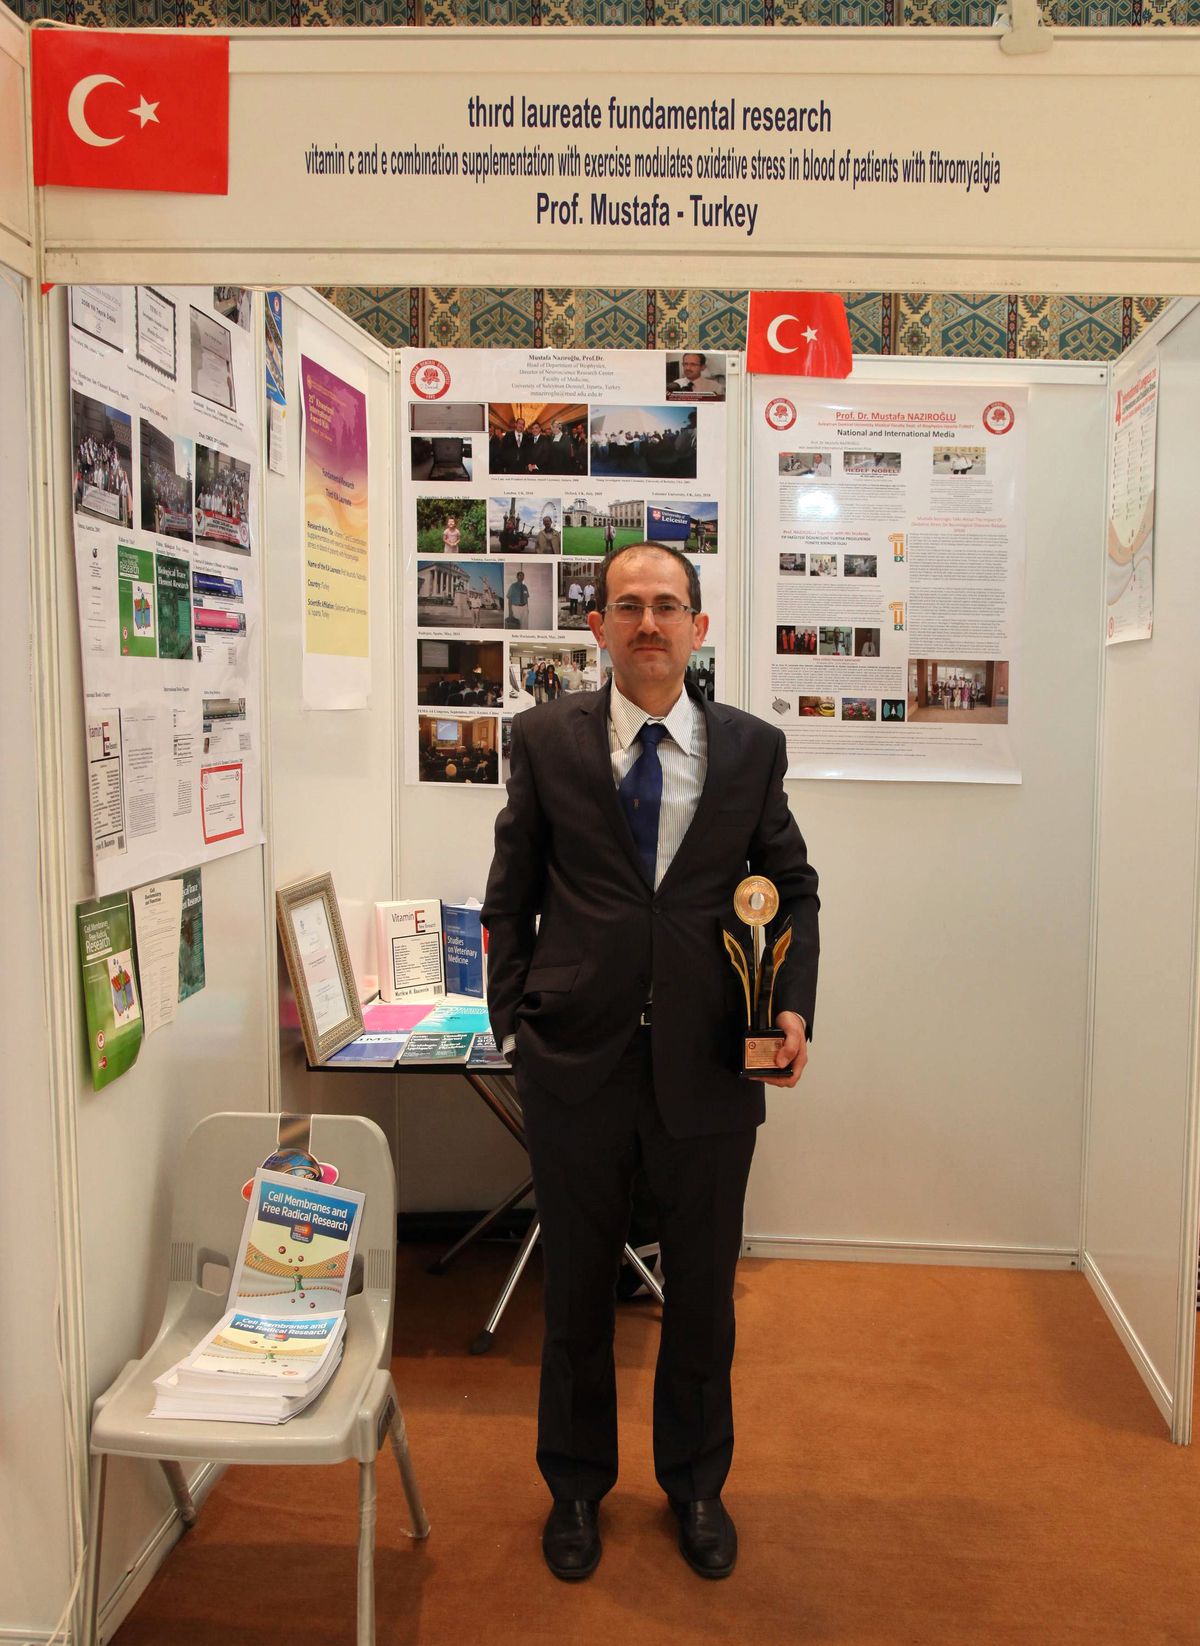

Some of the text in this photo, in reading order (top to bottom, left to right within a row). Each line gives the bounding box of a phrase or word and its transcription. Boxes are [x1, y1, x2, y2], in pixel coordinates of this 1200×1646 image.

[521, 95, 602, 129] laureate
[607, 95, 735, 131] fundamental
[742, 99, 832, 133] research
[304, 142, 345, 175] vitamin
[348, 151, 355, 175] c
[357, 143, 378, 175] and
[380, 151, 388, 175] e
[461, 143, 555, 184] supplementation
[557, 144, 581, 177] with
[584, 145, 632, 178] exercise
[634, 145, 693, 179] modulates
[696, 146, 748, 180] oxidative
[750, 149, 786, 181] stress
[789, 148, 800, 181] in
[802, 148, 836, 182] blood
[838, 148, 851, 182] of
[852, 149, 899, 190] patients
[902, 150, 926, 183] with
[929, 150, 1001, 194] fibromyalgia
[536, 192, 583, 225] Prof.
[590, 193, 670, 227] Mustafa
[689, 194, 759, 237] Turkey
[836, 411, 855, 420] Prof.
[857, 412, 869, 420] Dr.
[871, 412, 905, 421] Mustafa
[869, 429, 883, 437] and
[661, 516, 688, 525] Leicester
[391, 909, 426, 934] Vitamin E
[85, 936, 111, 954] Research
[447, 935, 465, 946] Studies
[454, 945, 478, 959] Veterinary
[447, 954, 469, 966] Medicine
[268, 1191, 348, 1219] Cell Membranes and
[262, 1202, 348, 1232] Free Radical Research
[235, 1321, 255, 1329] Free
[255, 1324, 288, 1334] Radical
[260, 1321, 309, 1330] Membranes
